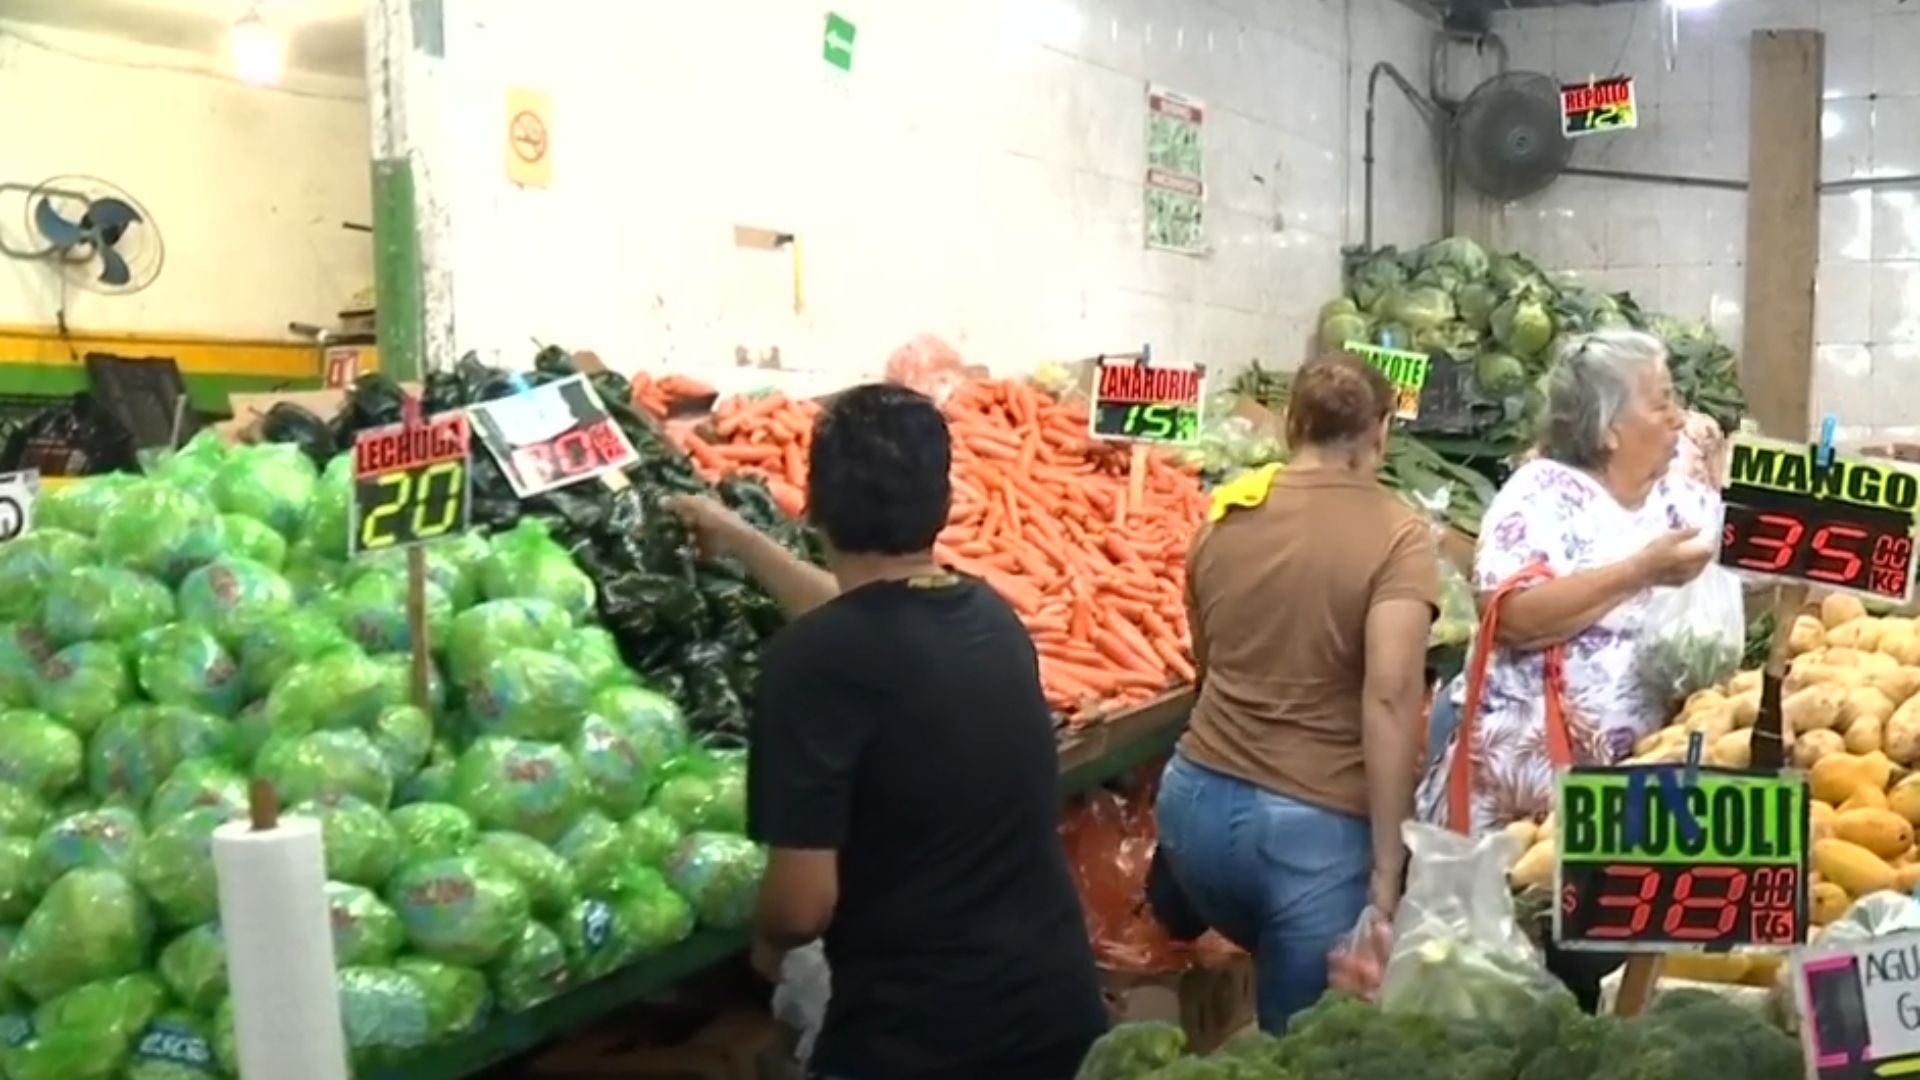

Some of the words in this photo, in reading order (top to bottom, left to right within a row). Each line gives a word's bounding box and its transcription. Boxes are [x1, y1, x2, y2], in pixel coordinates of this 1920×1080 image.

[1565, 83, 1629, 110] REPOLLO
[1123, 404, 1173, 438] 15
[361, 461, 463, 549] 20
[1730, 443, 1918, 509] MANGO
[1737, 513, 1869, 583] 35
[1563, 784, 1793, 858] BROCOLI
[1585, 864, 1748, 940] 38
